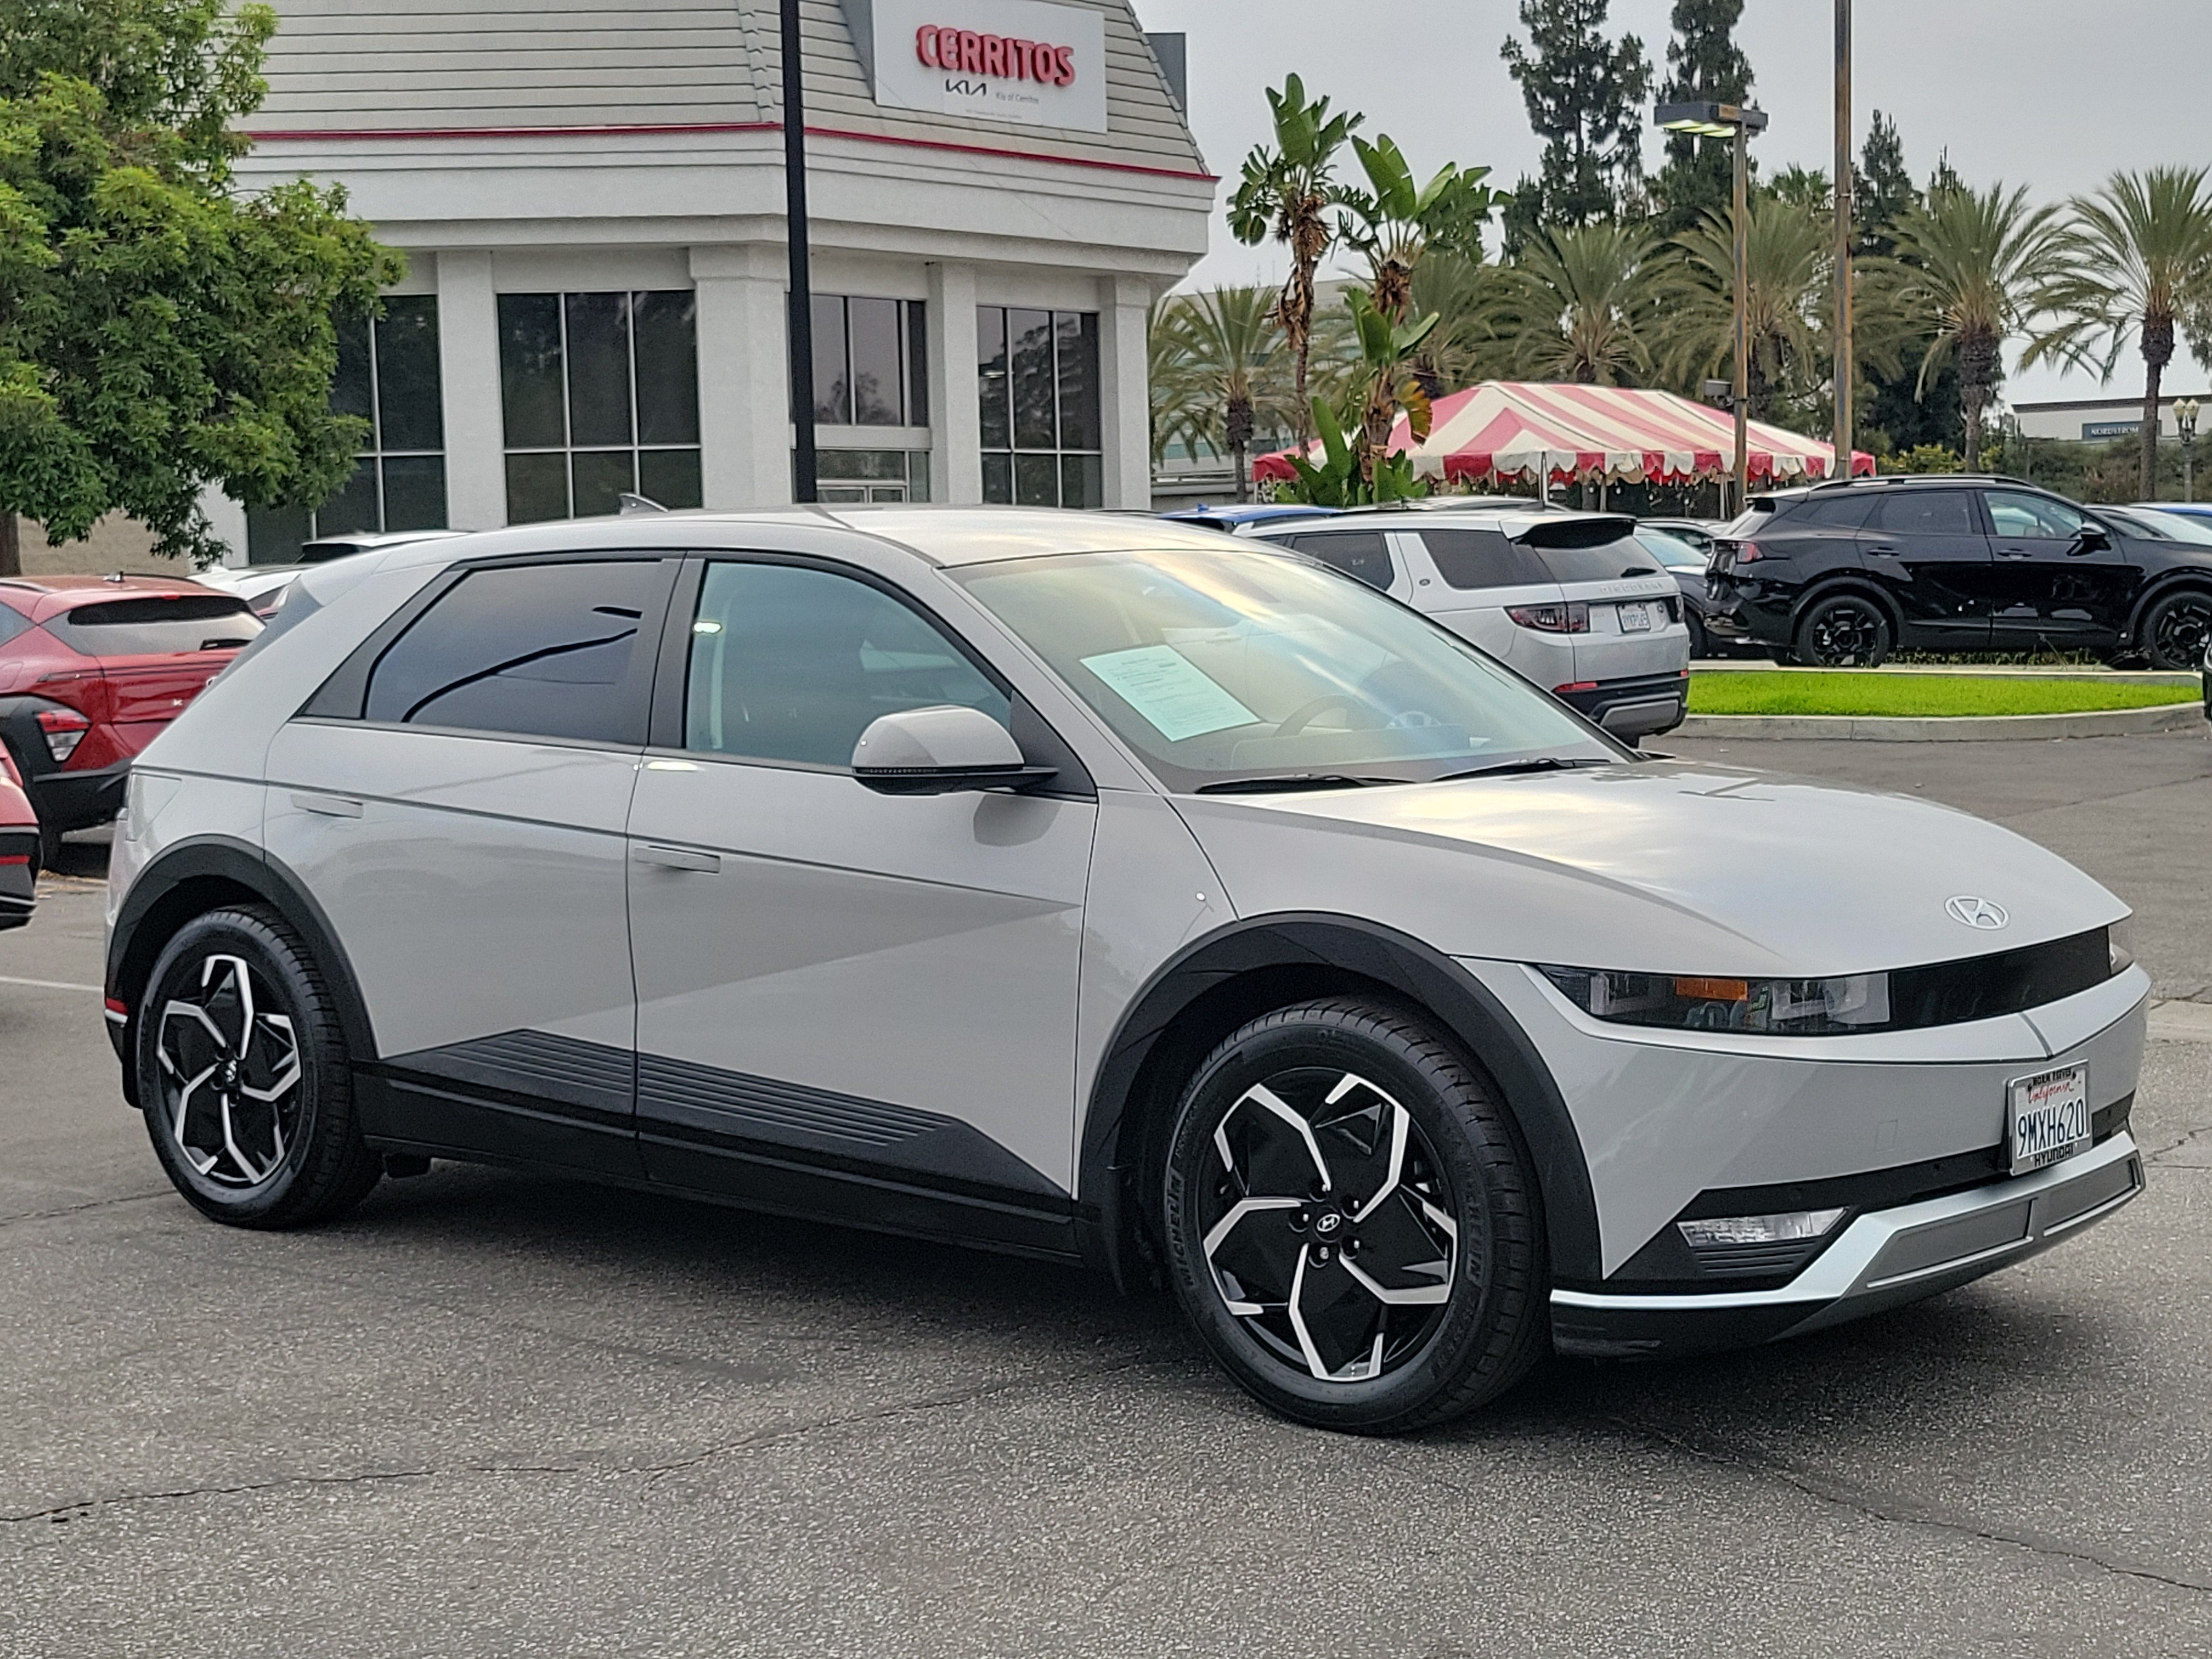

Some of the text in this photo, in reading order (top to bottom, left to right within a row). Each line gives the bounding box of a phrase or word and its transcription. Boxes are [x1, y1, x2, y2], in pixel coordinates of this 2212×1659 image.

[916, 24, 1076, 87] CERRITOS
[945, 78, 987, 97] KIA
[2028, 1081, 2075, 1106] California
[2018, 1098, 2086, 1157] 9MXH620
[2034, 1143, 2075, 1167] HYUNDAI
